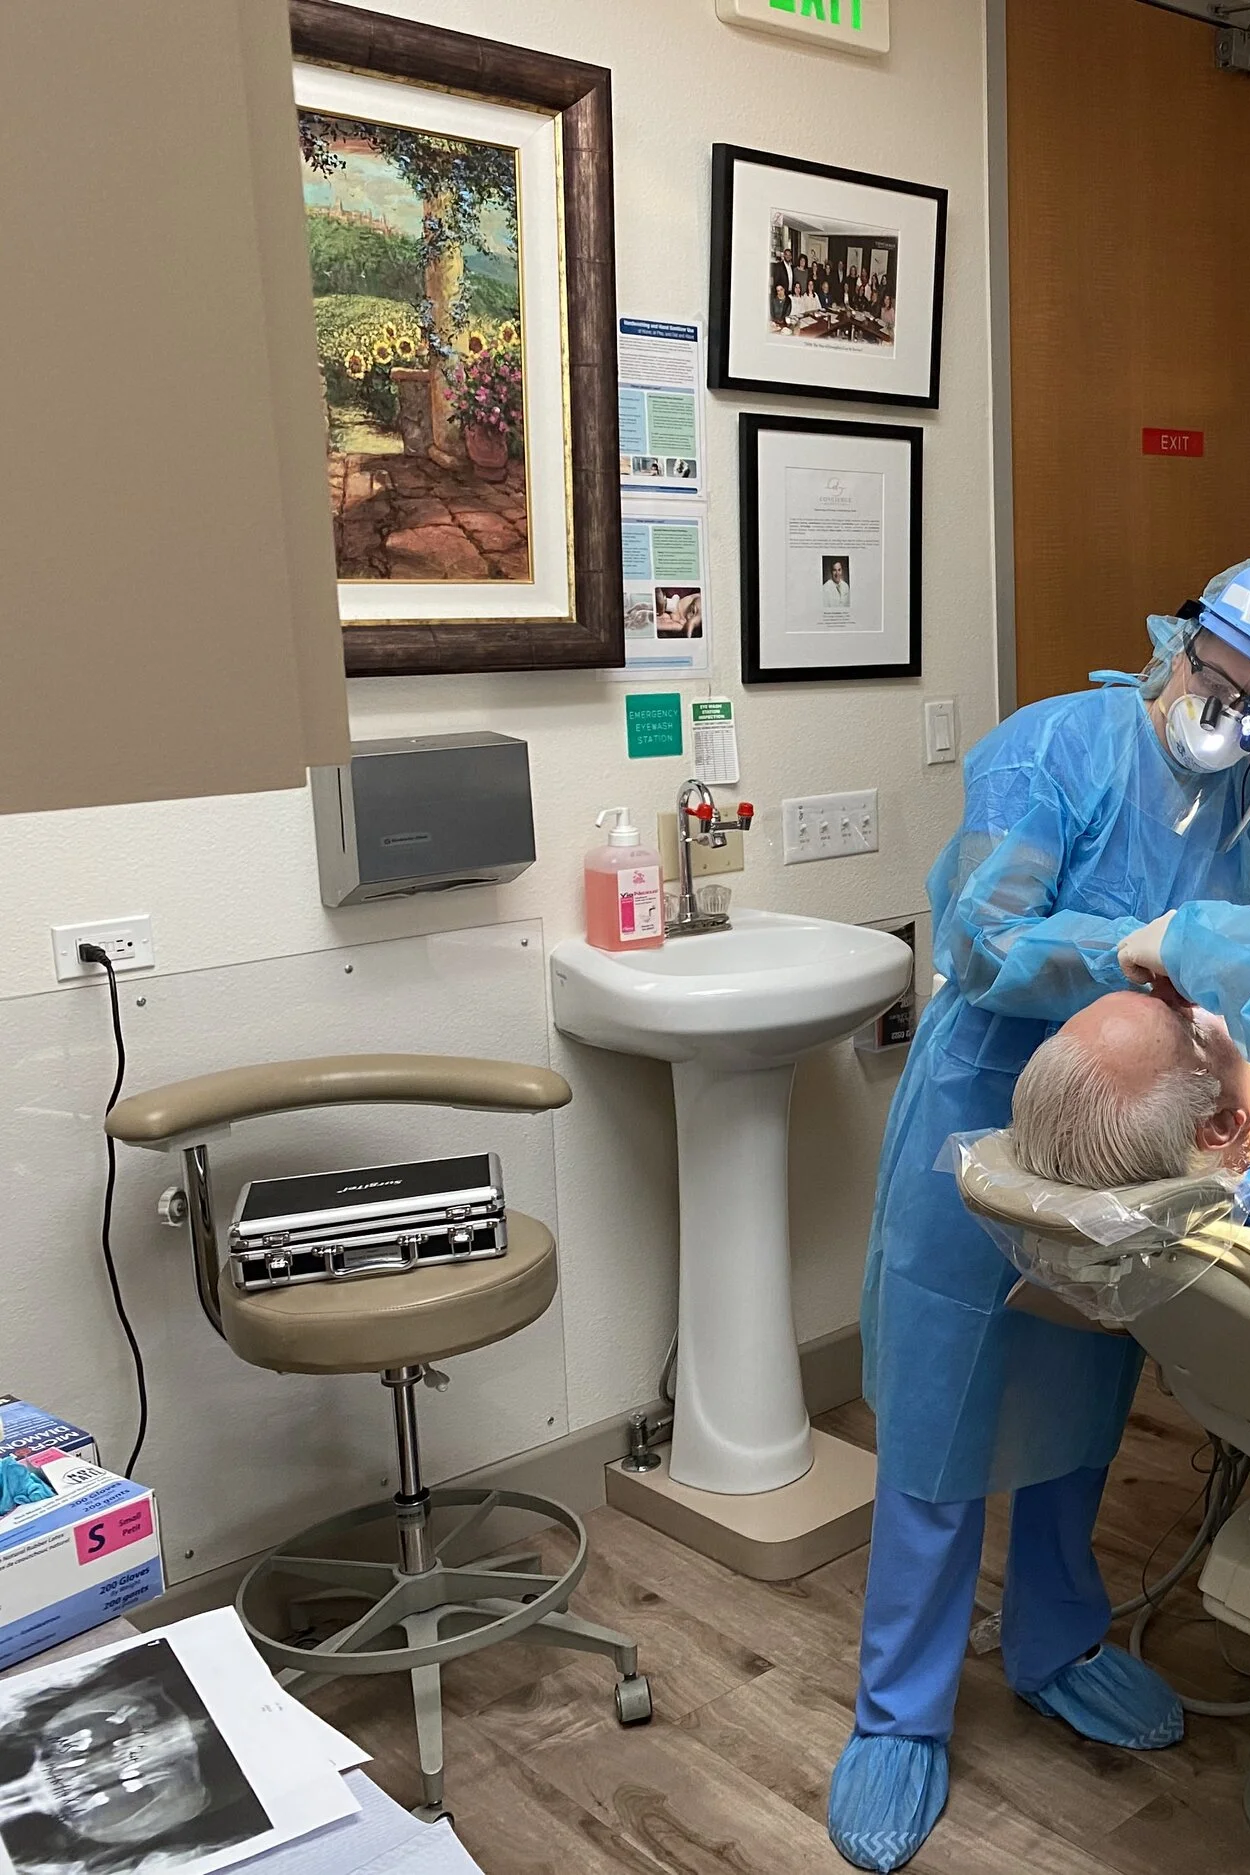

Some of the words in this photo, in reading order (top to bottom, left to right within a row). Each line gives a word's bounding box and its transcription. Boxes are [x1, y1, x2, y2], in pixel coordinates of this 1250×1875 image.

[1161, 434, 1189, 451] EXIT
[629, 709, 678, 720] EMERGENCY
[635, 722, 673, 732] EYEWASH
[637, 734, 673, 745] STATION
[0, 1425, 70, 1453] DIAMON
[70, 1497, 88, 1508] 200
[89, 1482, 122, 1499] Gloves
[83, 1502, 101, 1513] 200
[103, 1489, 131, 1504] gants
[118, 1511, 142, 1527] Small
[88, 1522, 106, 1554] S
[122, 1524, 141, 1536] Petit
[26, 1539, 48, 1551] Rubber
[99, 1580, 118, 1595] 200
[119, 1567, 150, 1586] Gloves
[103, 1596, 122, 1610] 200
[122, 1585, 149, 1602] gants
